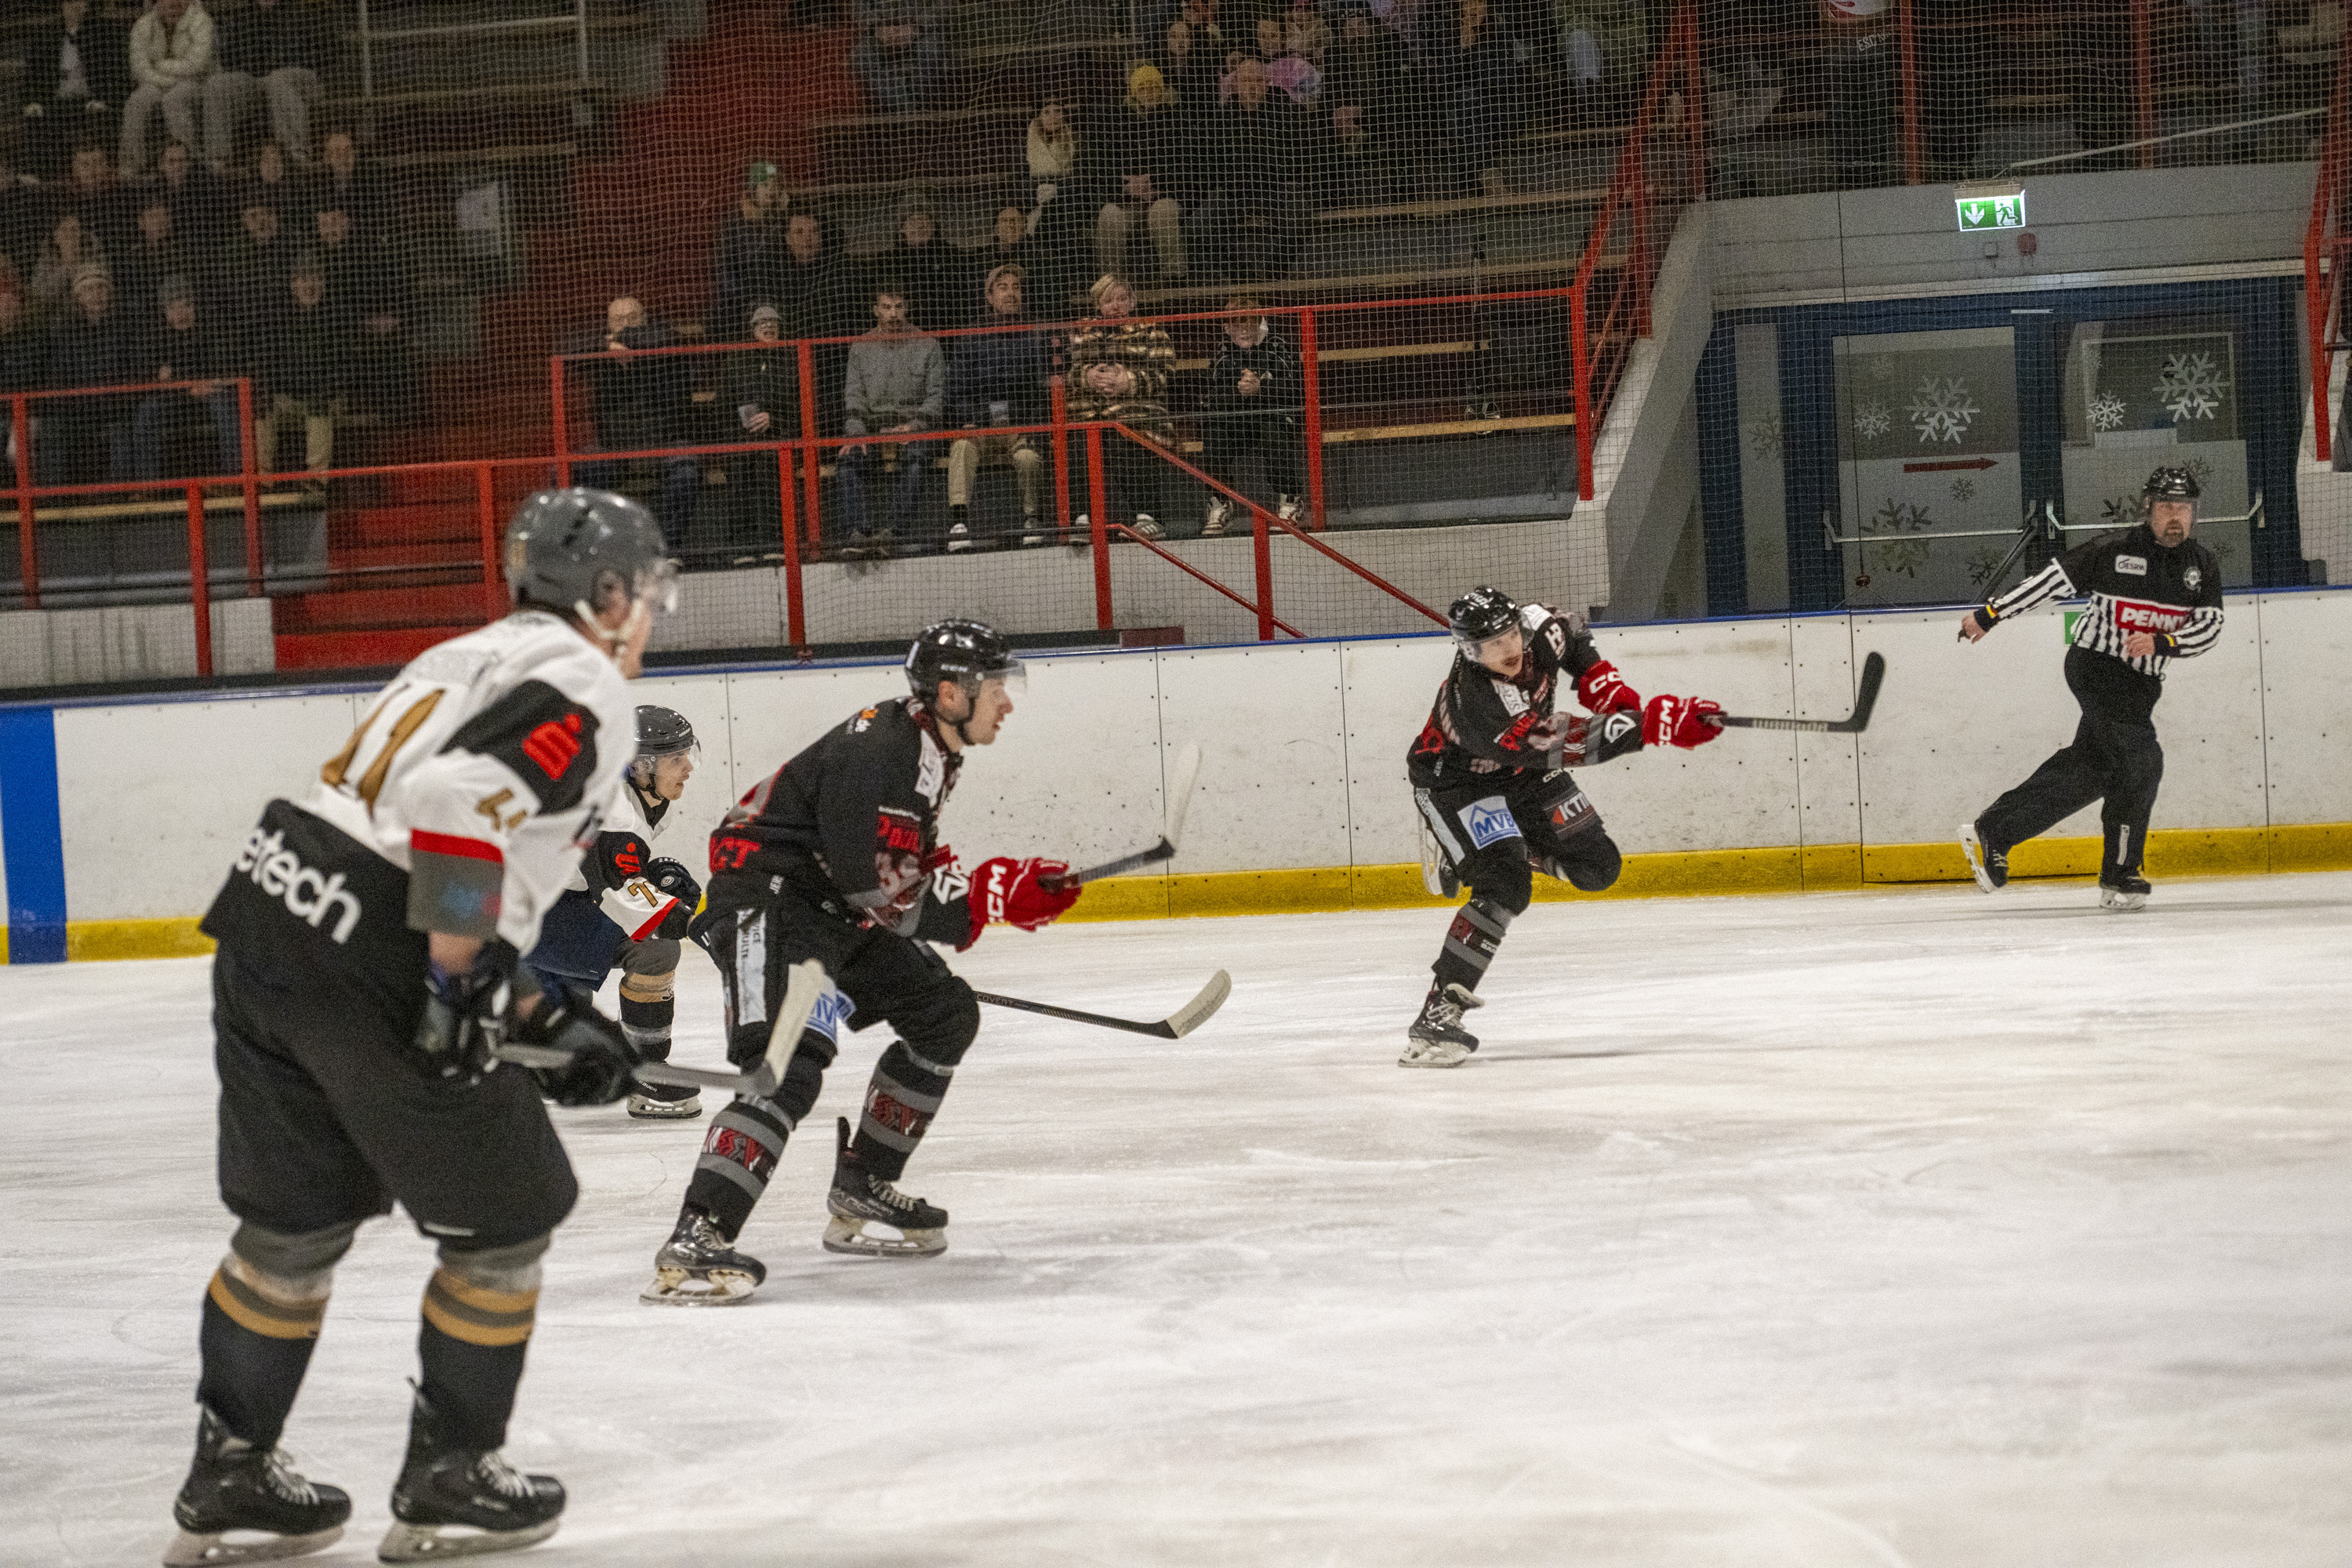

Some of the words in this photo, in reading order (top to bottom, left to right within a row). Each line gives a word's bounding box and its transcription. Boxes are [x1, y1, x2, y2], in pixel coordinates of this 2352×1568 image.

[1589, 670, 1621, 694] CC
[1475, 812, 1515, 839] MVB
[976, 993, 1015, 1007] COVERT
